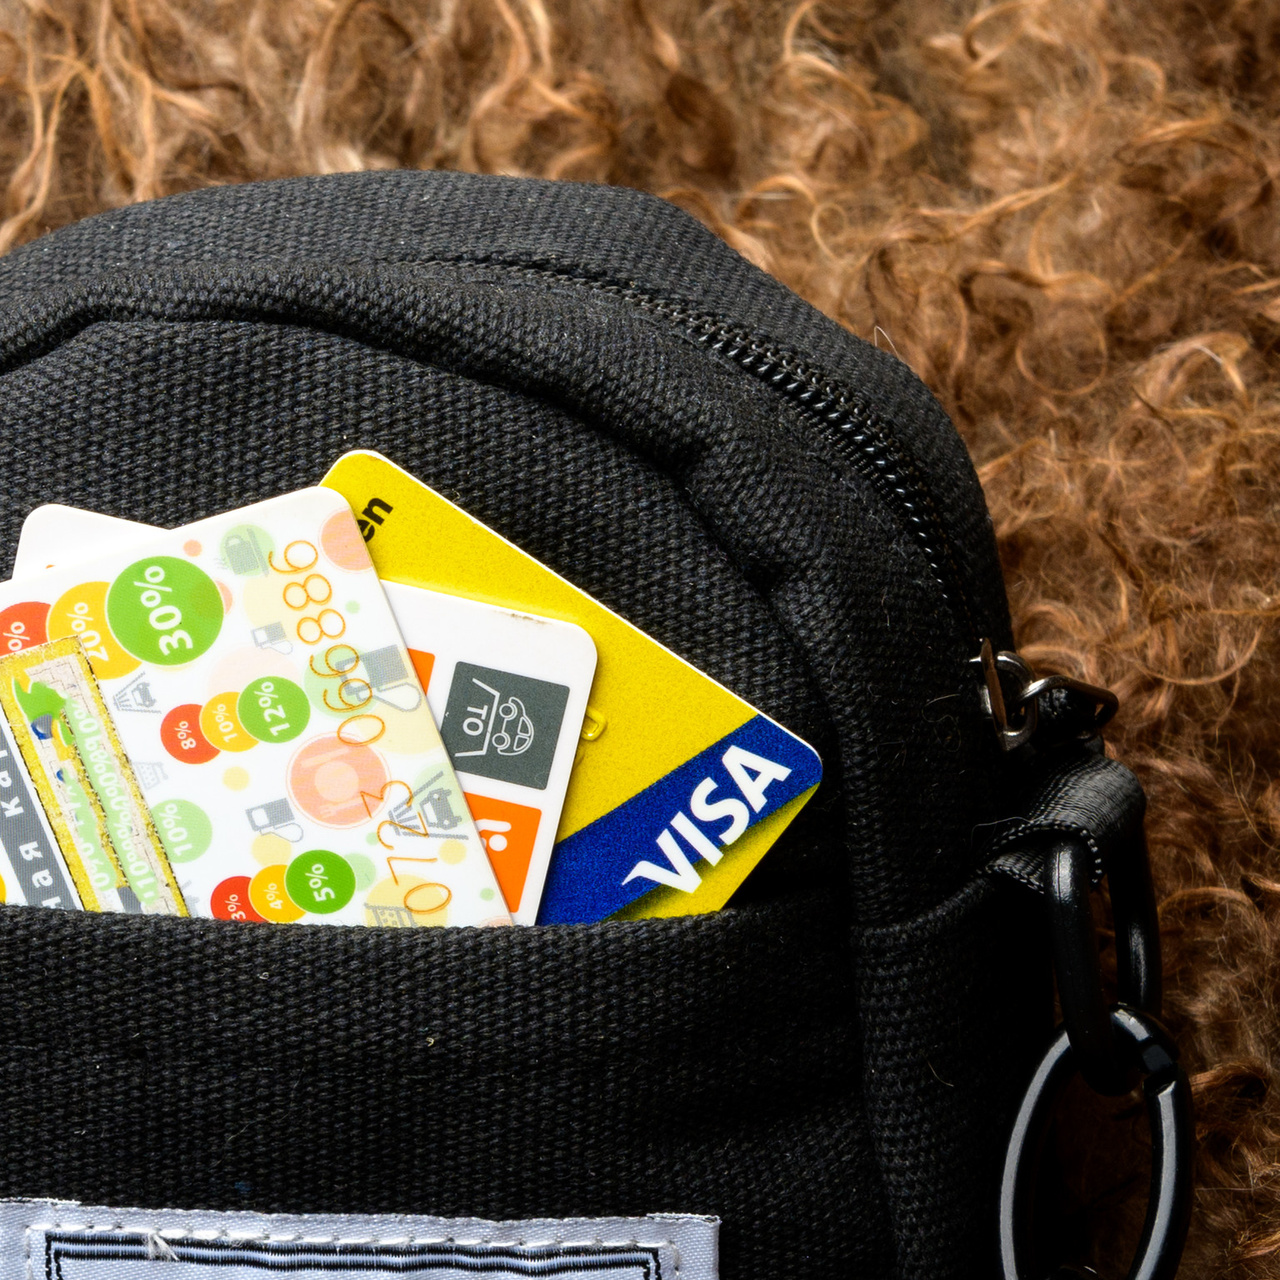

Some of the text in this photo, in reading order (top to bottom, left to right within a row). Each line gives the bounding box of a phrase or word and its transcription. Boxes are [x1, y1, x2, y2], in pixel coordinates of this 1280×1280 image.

[133, 564, 194, 657] 30%
[267, 539, 387, 747] 066886
[173, 719, 197, 751] 8%
[210, 702, 236, 744] 10%
[253, 680, 291, 737] 12%
[158, 803, 194, 858] 10%
[621, 744, 793, 895] VISA
[262, 881, 283, 910] 4%
[303, 862, 337, 903] 5%
